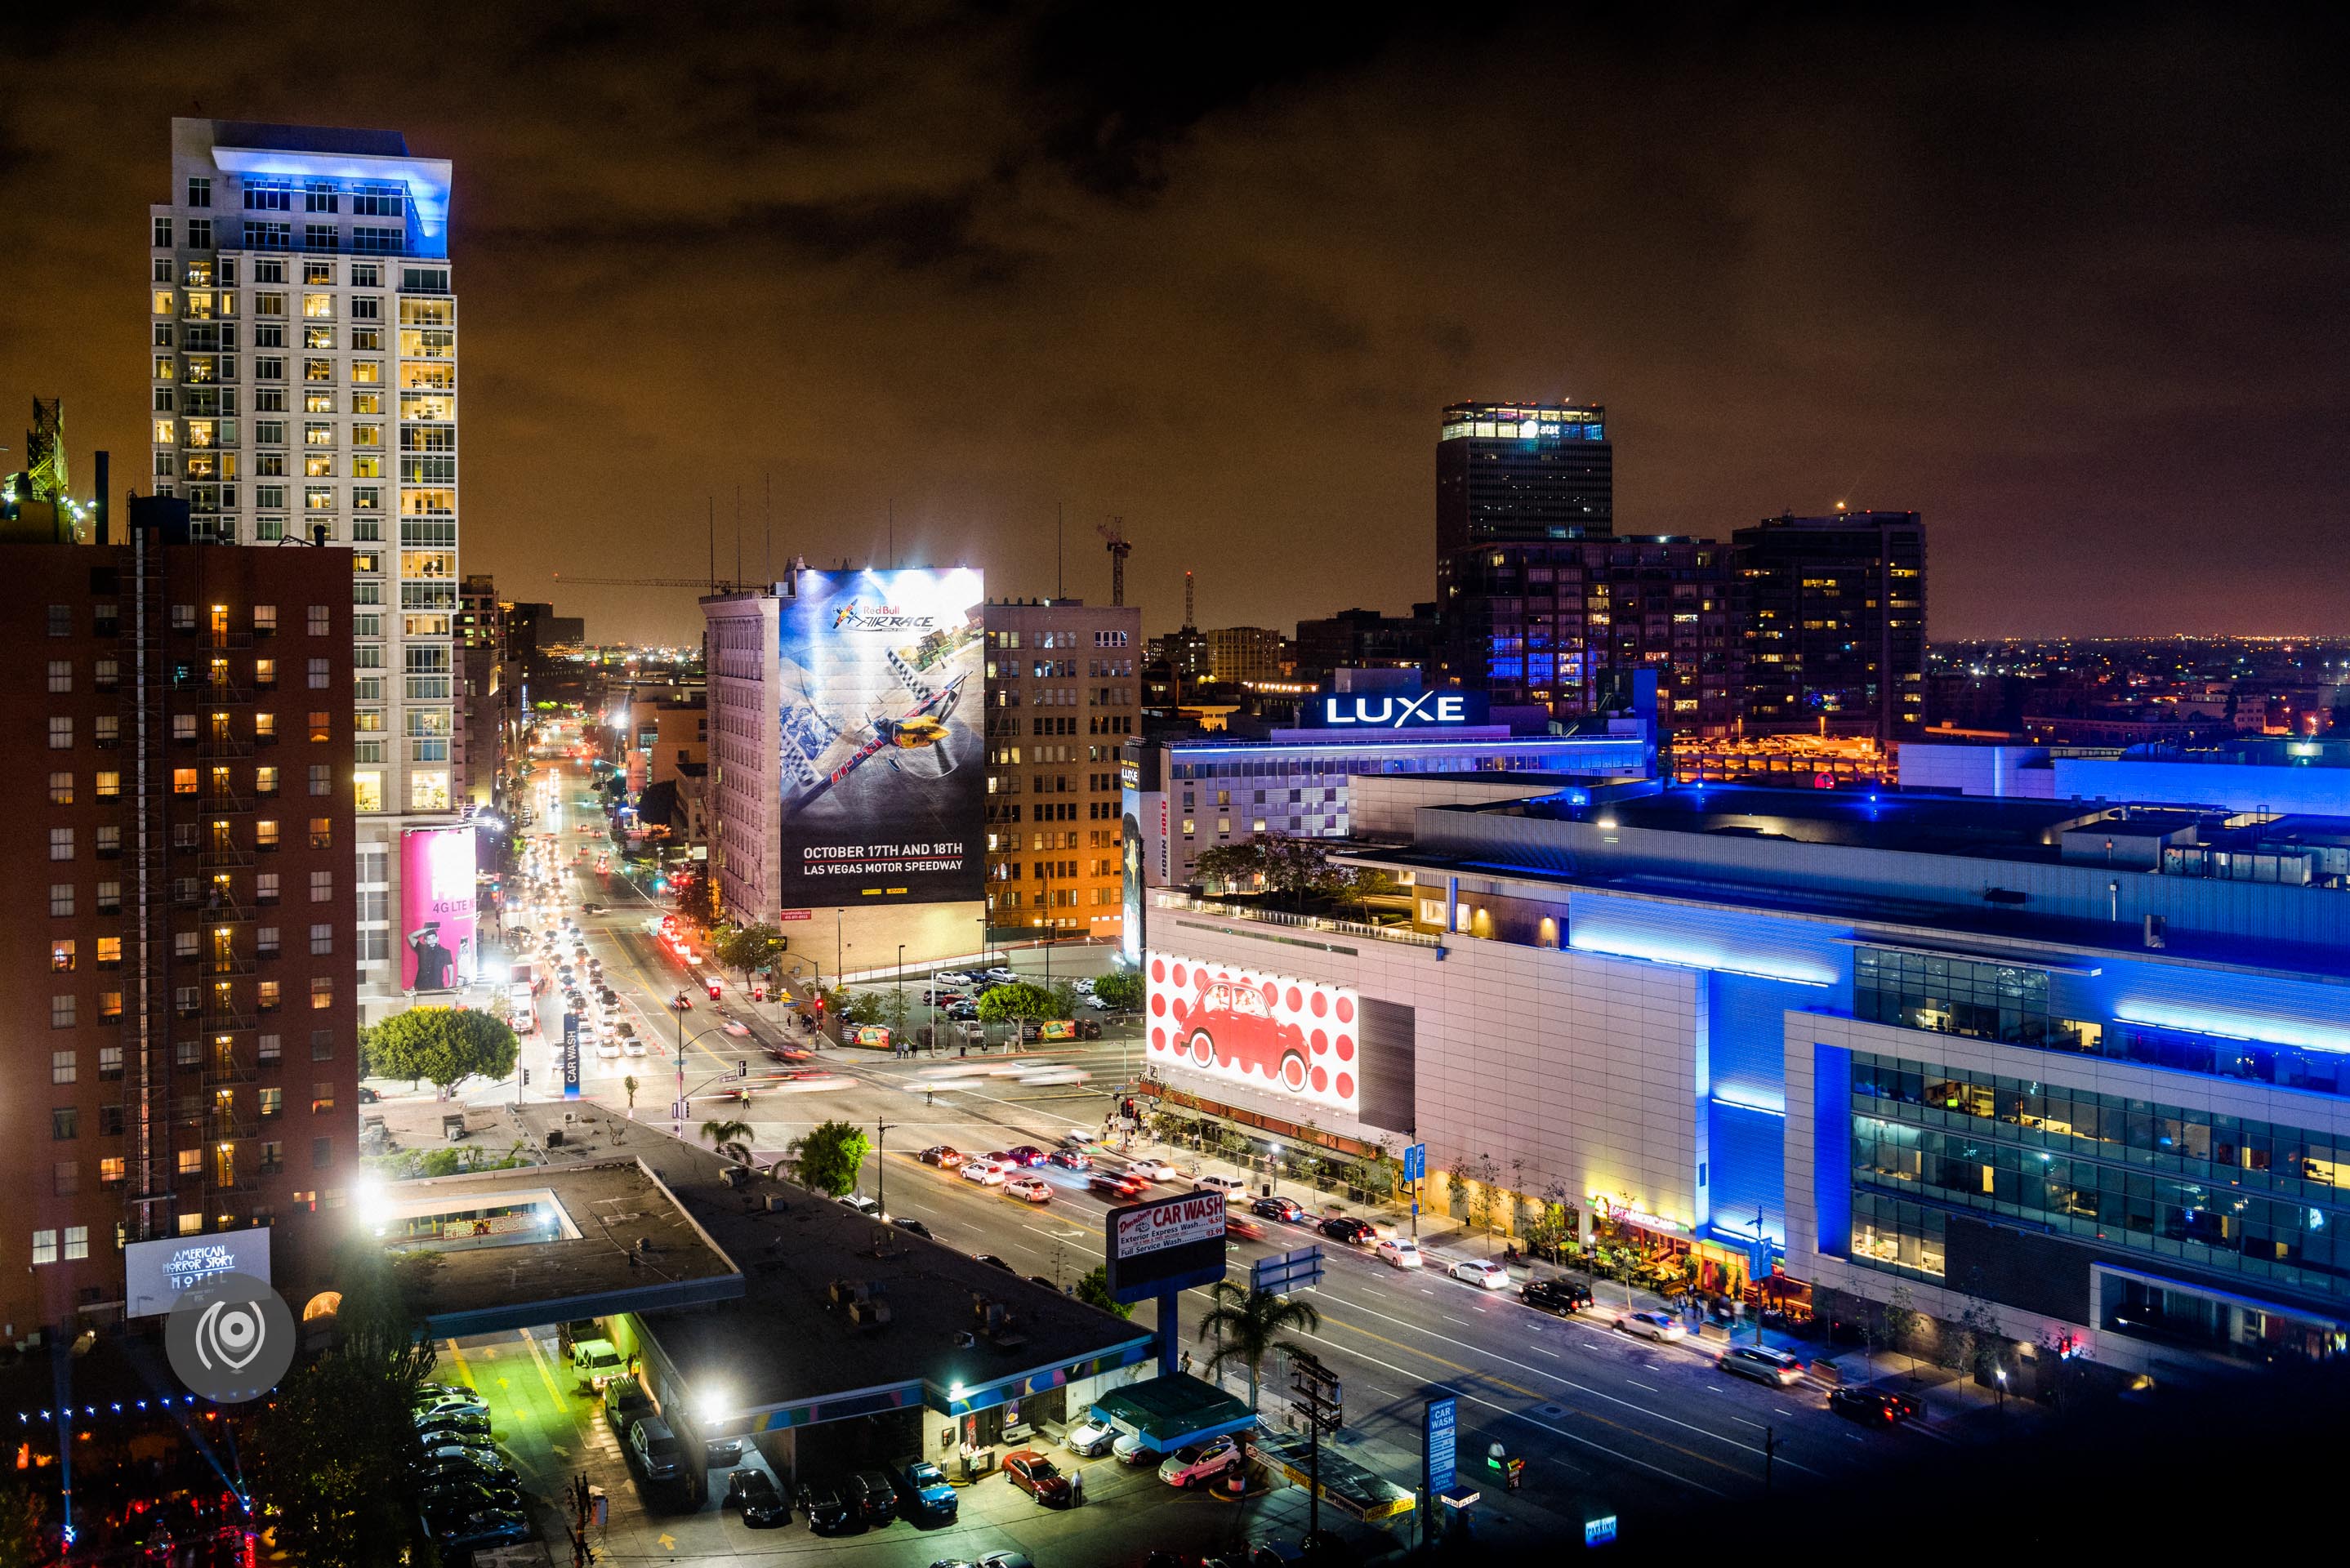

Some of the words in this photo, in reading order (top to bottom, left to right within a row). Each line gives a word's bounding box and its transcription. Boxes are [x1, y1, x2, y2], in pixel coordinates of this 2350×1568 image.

[863, 605, 881, 615] Red
[882, 605, 900, 615] Bull
[859, 617, 888, 627] AIR
[889, 617, 934, 627] RACE
[1327, 690, 1465, 728] LUXE
[1121, 768, 1138, 782] LUXE
[804, 846, 864, 859] OCTOBER
[867, 844, 899, 858] 17TH
[902, 844, 930, 856] AND
[933, 842, 963, 854] 18TH
[804, 864, 825, 875] LAS
[827, 863, 863, 875] VEGAS
[865, 862, 903, 873] MOTOR
[904, 860, 963, 871] SPEEDWAY
[433, 902, 449, 914] 4G
[451, 899, 467, 911] LTE
[567, 1030, 577, 1061] WASH
[567, 1061, 577, 1083] CAR
[1119, 1209, 1153, 1233] Downtown
[1153, 1205, 1182, 1228] CAR
[1183, 1196, 1224, 1222] WASH
[1121, 1232, 1149, 1245] Exterior
[1152, 1225, 1179, 1237] Express
[173, 1245, 225, 1262] AMERICAN
[1121, 1248, 1134, 1257] Full
[1135, 1242, 1161, 1254] Service
[163, 1258, 203, 1273] HORROR
[205, 1254, 235, 1268] STORY
[172, 1270, 228, 1290] HOTEL
[1430, 1401, 1455, 1411] DOWNTOWN
[1434, 1407, 1451, 1419] CAR
[1431, 1415, 1454, 1429] WASH
[1587, 1521, 1615, 1536] PARKING
